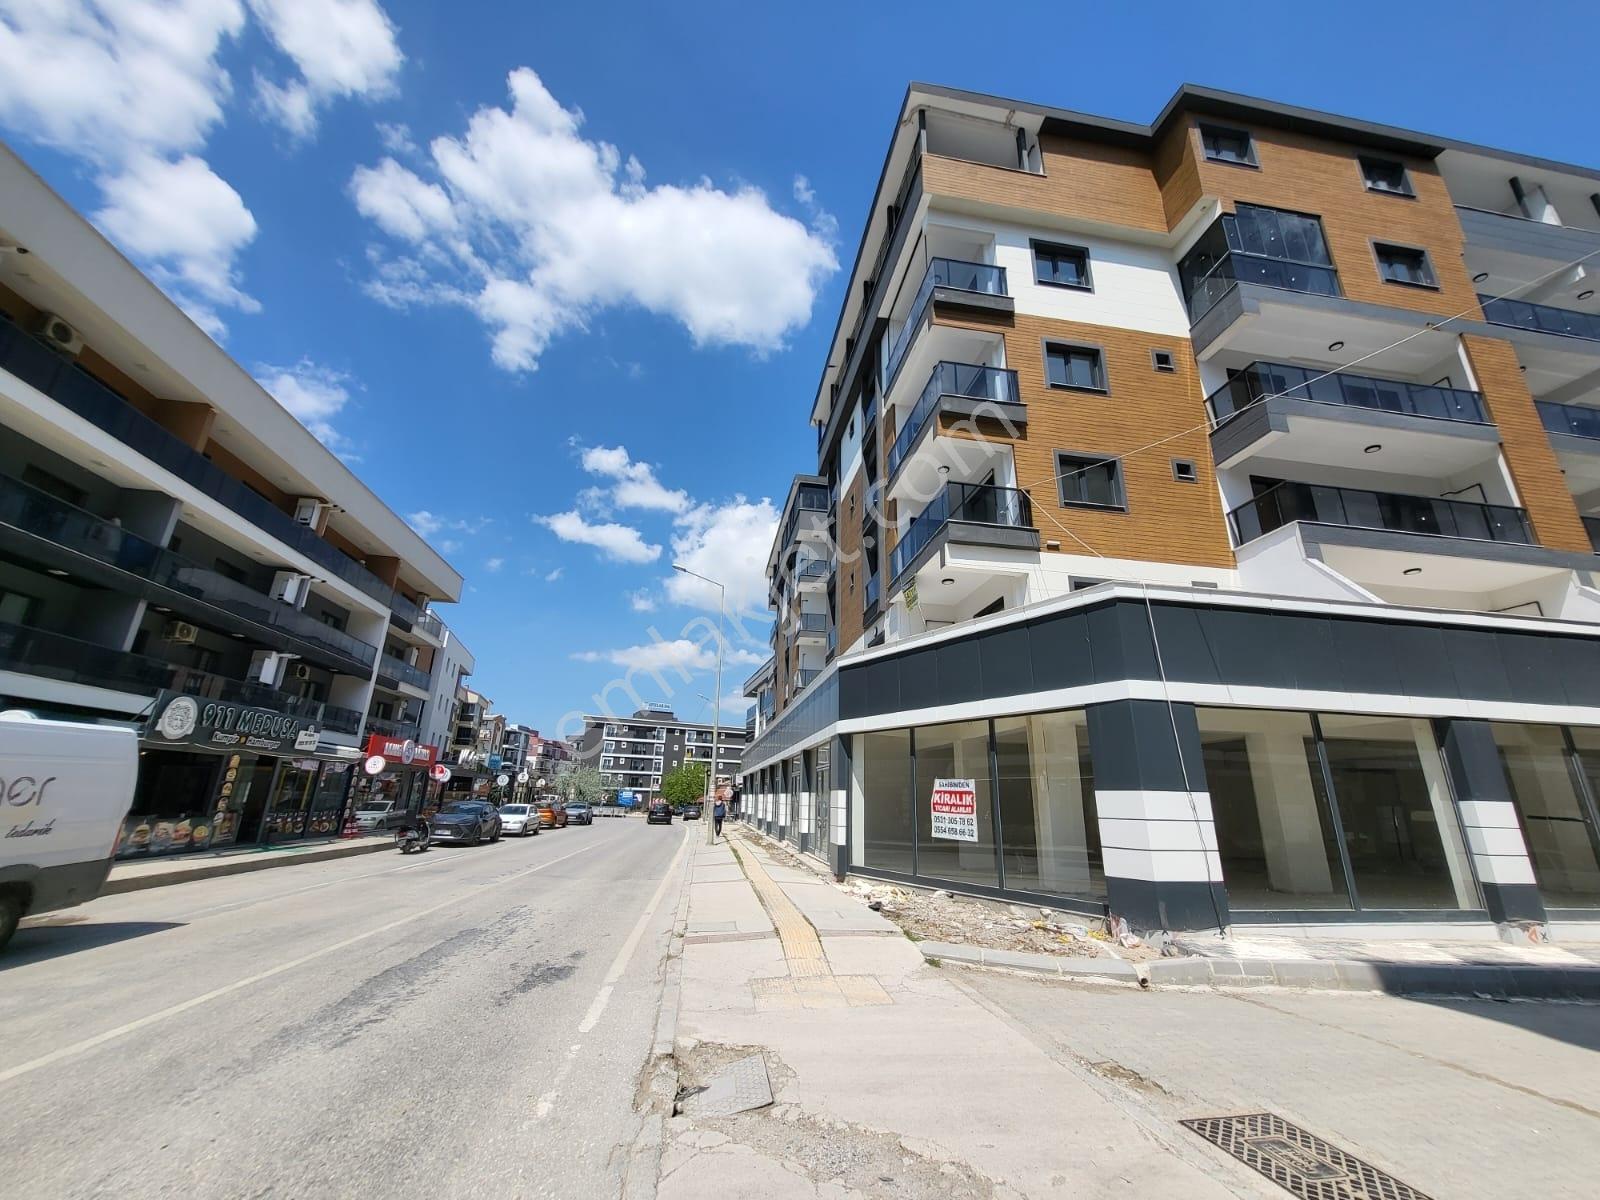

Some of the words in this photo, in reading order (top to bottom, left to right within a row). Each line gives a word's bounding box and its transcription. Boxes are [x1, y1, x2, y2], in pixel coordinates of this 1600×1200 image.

[202, 703, 236, 729] 911
[236, 710, 300, 739] MEDUSA
[934, 792, 973, 806] KİRALIK
